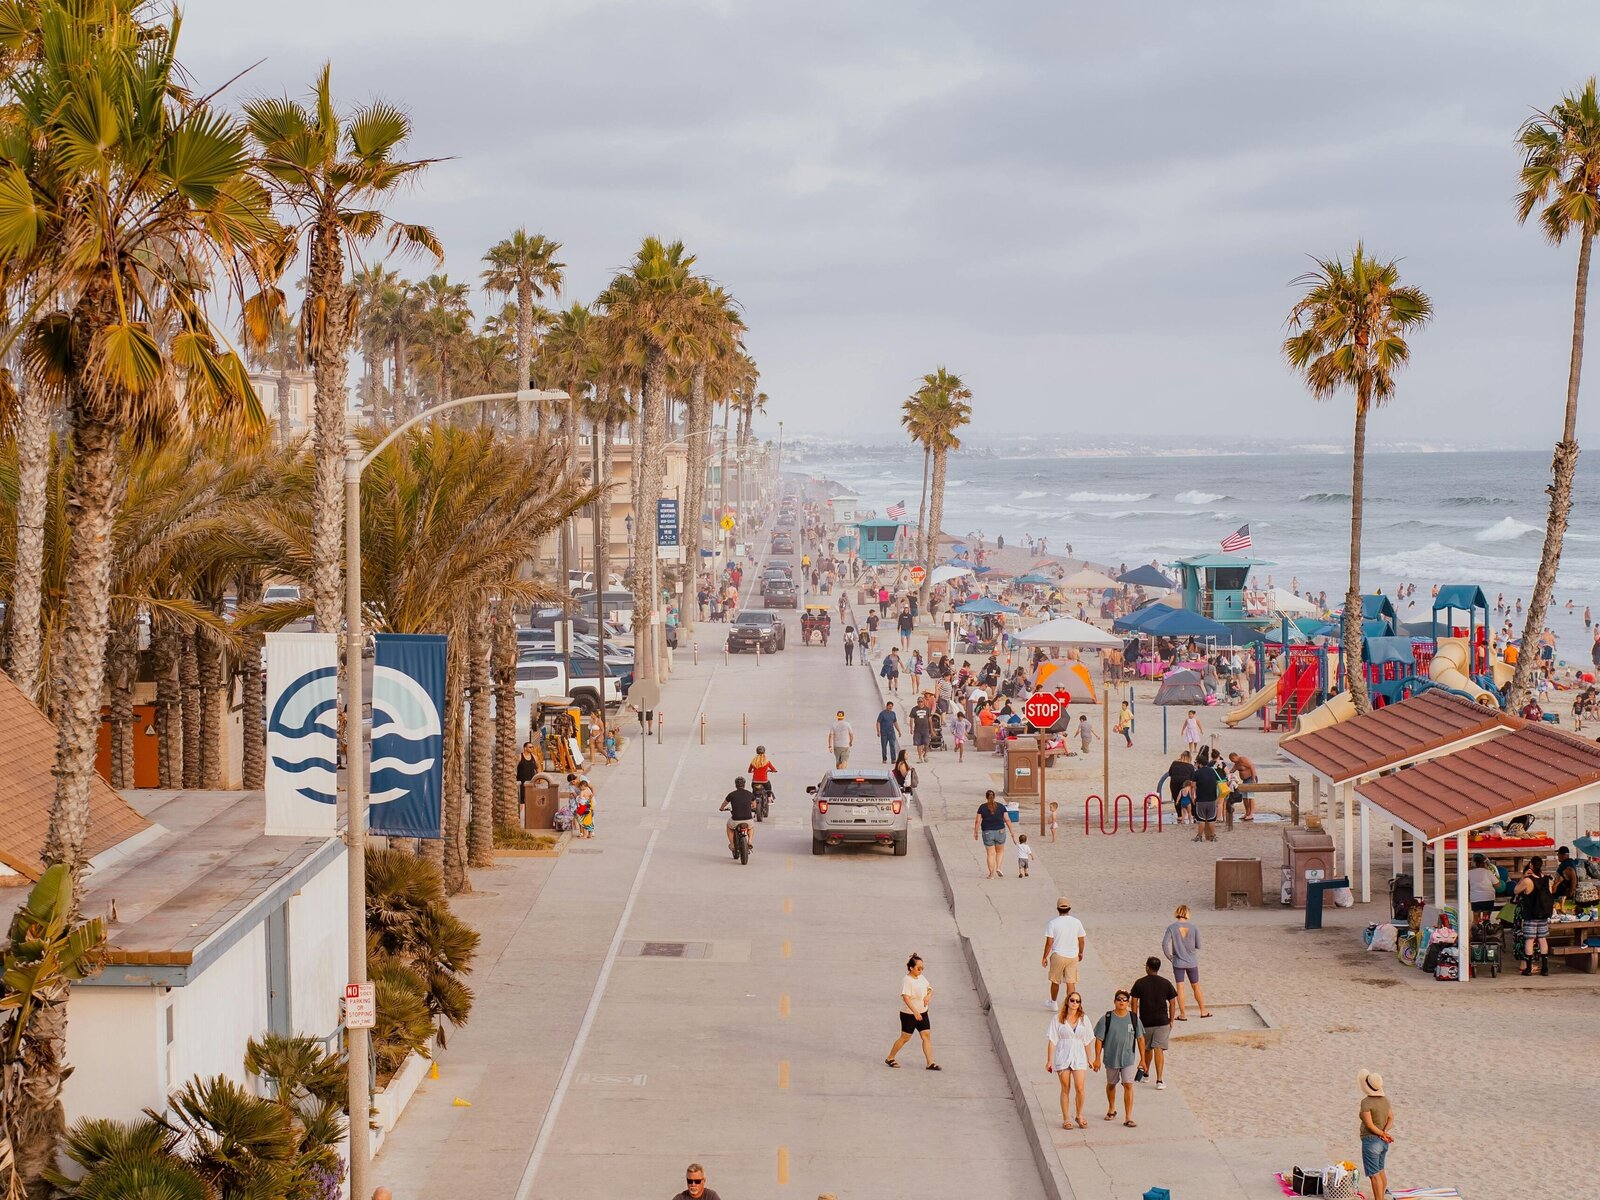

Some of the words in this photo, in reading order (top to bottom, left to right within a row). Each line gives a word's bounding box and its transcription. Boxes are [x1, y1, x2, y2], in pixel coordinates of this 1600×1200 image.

[843, 511, 852, 520] 5
[882, 544, 889, 553] 3
[1225, 595, 1232, 608] 1
[1027, 703, 1059, 717] STOP
[347, 986, 358, 997] NO
[349, 1010, 373, 1018] STOPPING
